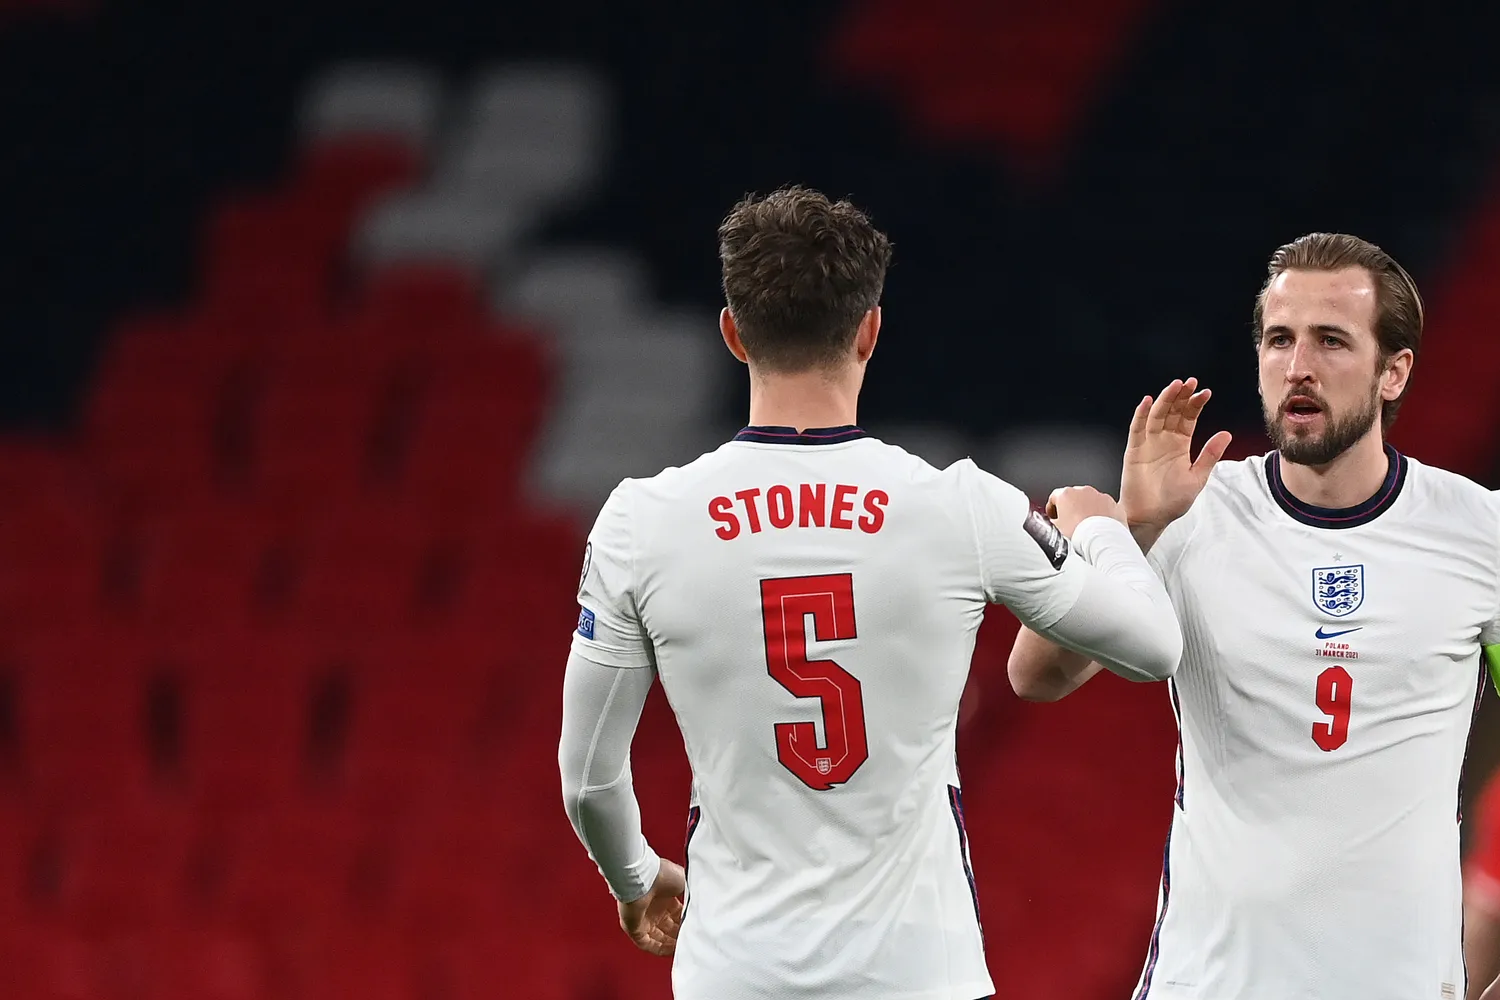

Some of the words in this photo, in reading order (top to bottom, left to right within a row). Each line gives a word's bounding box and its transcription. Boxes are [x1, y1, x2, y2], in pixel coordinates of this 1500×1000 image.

[708, 483, 889, 541] STONES
[1315, 648, 1322, 656] 31
[1323, 649, 1344, 658] MARCH
[1345, 651, 1359, 659] 2021
[1325, 642, 1350, 650] POLAND
[760, 572, 869, 791] 5
[1311, 666, 1353, 752] 9
